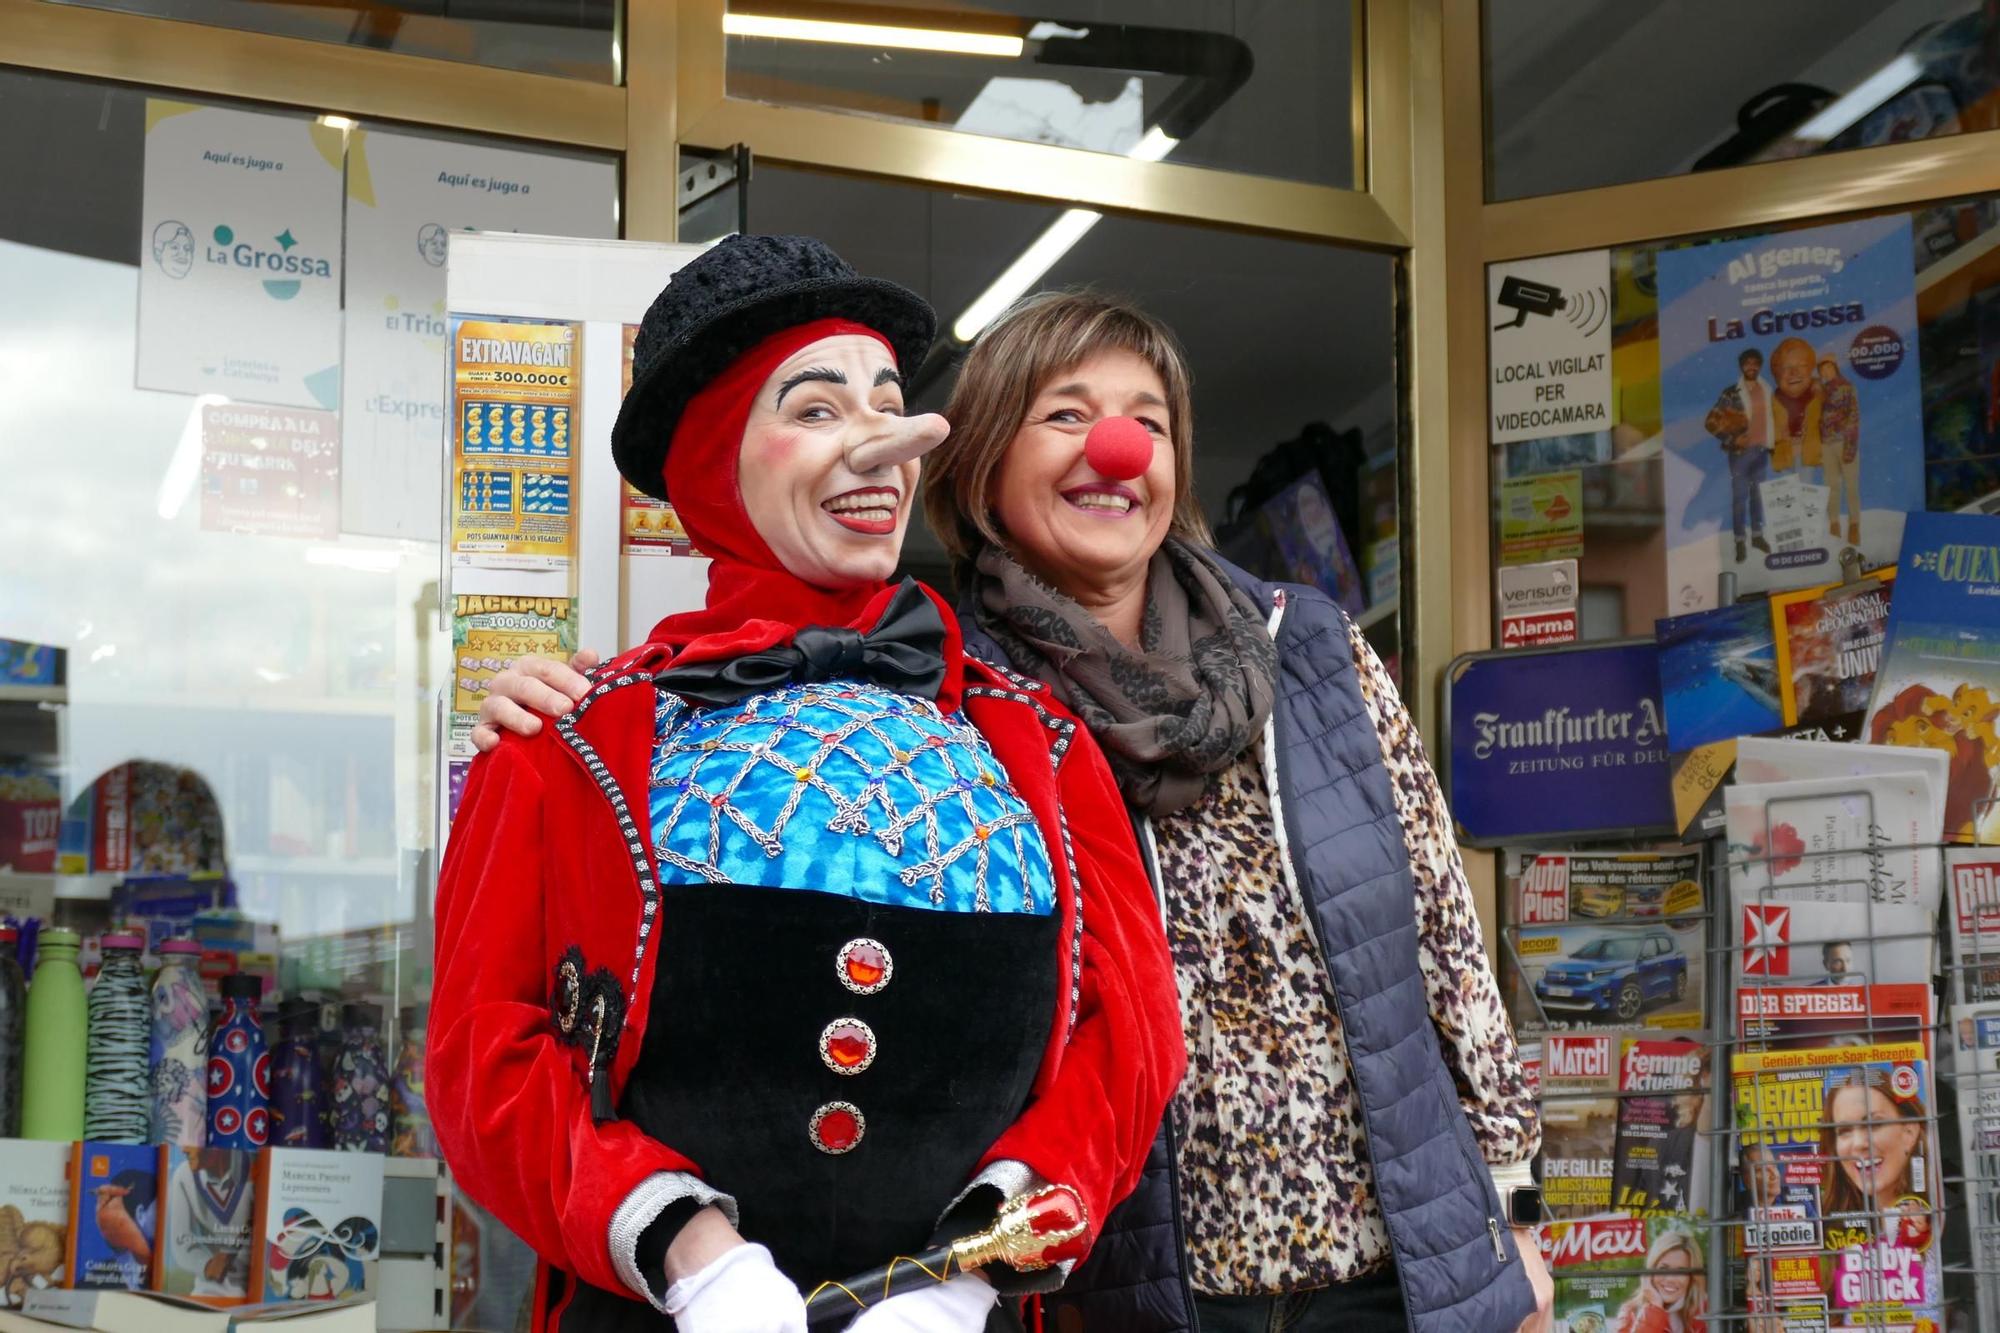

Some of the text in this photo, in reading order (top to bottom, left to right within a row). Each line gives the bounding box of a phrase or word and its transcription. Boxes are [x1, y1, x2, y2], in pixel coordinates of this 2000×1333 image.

[203, 150, 284, 172] Aquí es juga a
[438, 171, 530, 195] Aquí es juga a
[207, 244, 332, 279] La Grossa
[1727, 245, 1845, 285] Al gener,
[386, 313, 446, 337] El Trio
[1707, 300, 1866, 343] La Grossa
[462, 338, 572, 368] EXTRAVAGANT
[494, 371, 568, 386] 300.000€
[1496, 354, 1606, 384] LOCAL VIGILAT
[1536, 383, 1566, 402] PER
[209, 411, 283, 432] COMPRA
[1496, 403, 1606, 431] VIDEOCAMARA
[467, 533, 481, 541] POTS
[1504, 584, 1572, 602] verisure
[1822, 592, 1885, 617] NATIONAL
[455, 595, 570, 619] JACKPOT
[1815, 602, 1891, 634] GEOGRAPHIC
[488, 616, 555, 629] 100.000€
[1504, 619, 1574, 638] Alarma
[1474, 706, 1633, 759] Frankfurter
[1509, 751, 1627, 775] ZEITUNG FÜR
[1825, 816, 1837, 874] Palestne,
[1523, 857, 1566, 893] Auto
[1571, 861, 1589, 872] Les
[1591, 860, 1652, 874] Volkswagen
[1571, 873, 1606, 885] encore
[1608, 872, 1626, 885] des
[1524, 892, 1566, 922] Plus
[1741, 994, 1780, 1015] DER
[1783, 993, 1866, 1013] SPIEGEL
[1549, 1038, 1609, 1075] MATCH
[1625, 1047, 1701, 1075] Femme
[1762, 1046, 1916, 1068] Geniale Super-Spar-Rezepte
[1624, 1073, 1694, 1091] Actuelle
[1570, 1159, 1614, 1178] GILLES
[1618, 1187, 1647, 1206] La
[1552, 1222, 1646, 1261] Maxi
[1774, 1269, 1815, 1281] GEFAHR!
[1590, 1289, 1609, 1299] 2024
